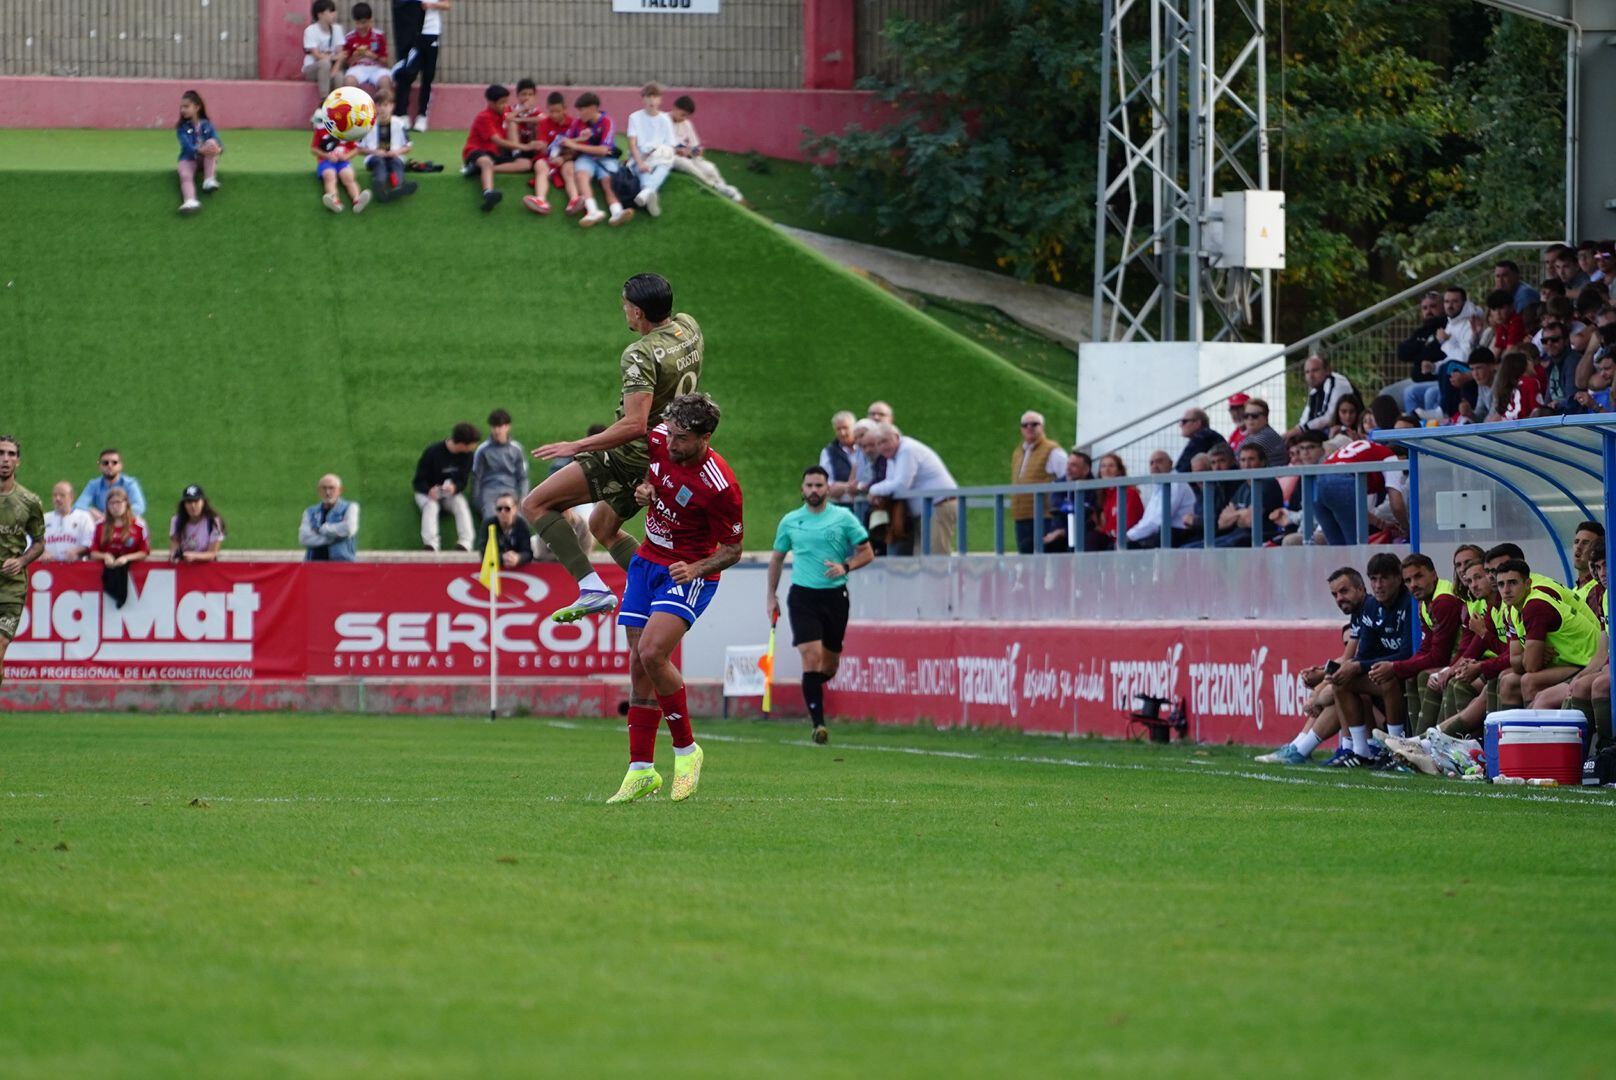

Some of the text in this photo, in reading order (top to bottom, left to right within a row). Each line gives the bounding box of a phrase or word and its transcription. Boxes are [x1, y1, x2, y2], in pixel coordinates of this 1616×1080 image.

[333, 654, 455, 668] SISTEMAS
[518, 654, 626, 668] SEGURID
[4, 664, 253, 680] ENDA PROFESIONAL DE LA CONSTRUCCIÓN
